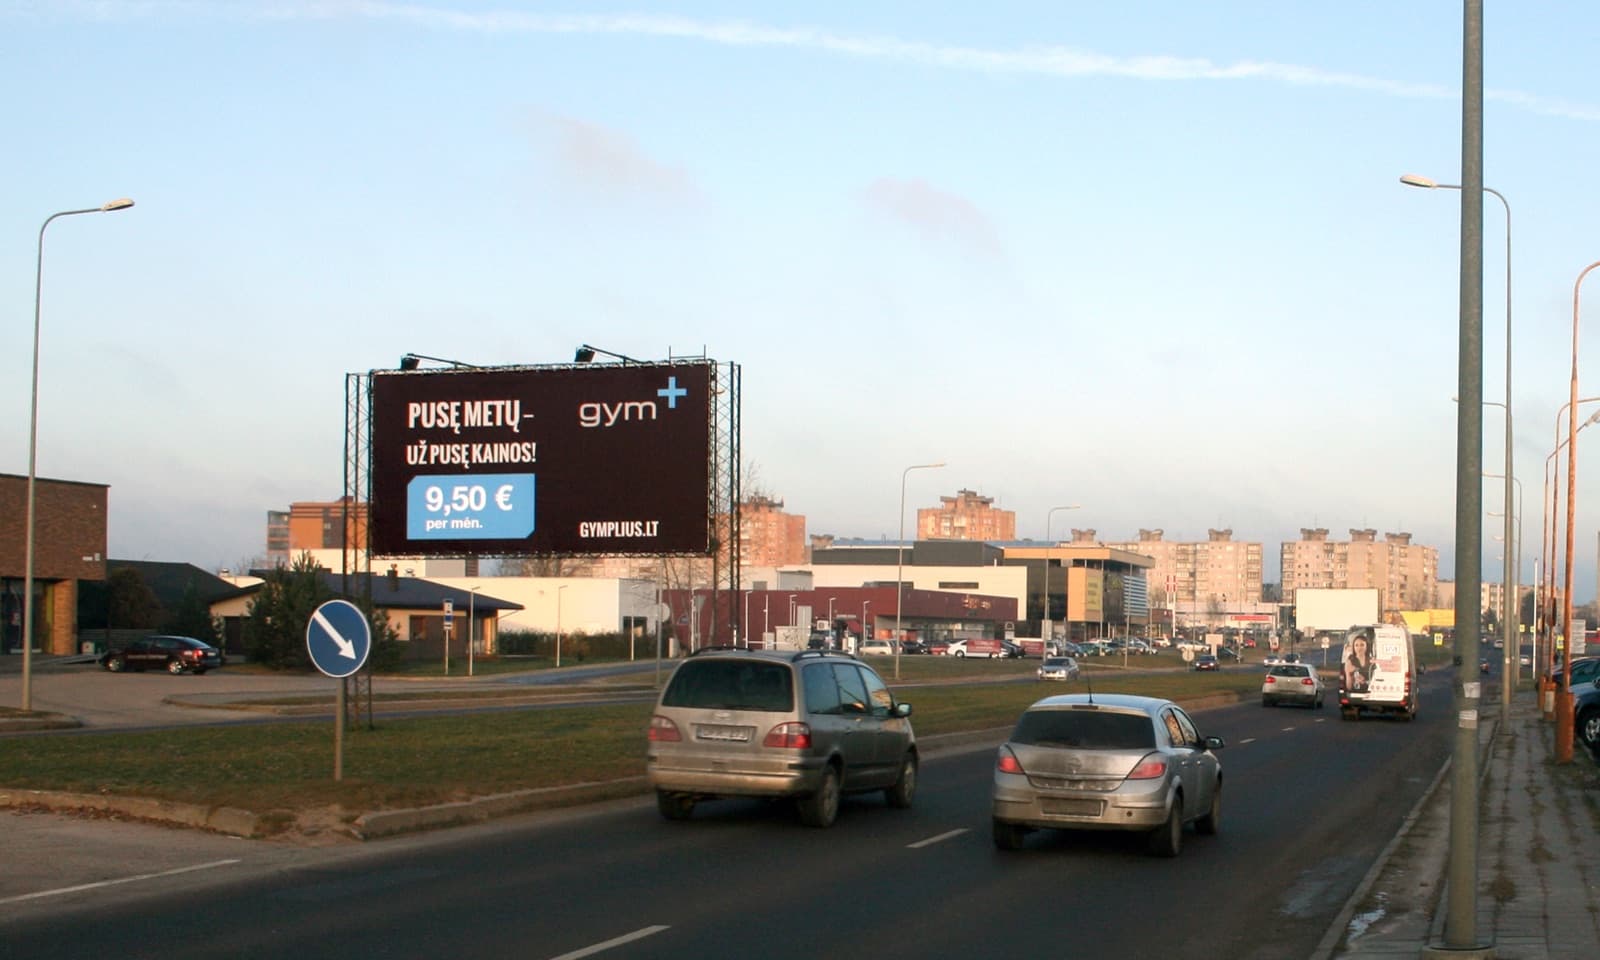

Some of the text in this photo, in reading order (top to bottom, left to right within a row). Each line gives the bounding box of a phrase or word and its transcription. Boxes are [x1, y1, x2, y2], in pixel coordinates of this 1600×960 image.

[408, 400, 461, 435] PUSĘ
[464, 399, 521, 433] METŲ
[406, 440, 537, 470] UŽ PUSĘ KAINOS!
[425, 484, 514, 517] 9,50 €
[425, 516, 484, 532] per mėn.
[579, 520, 660, 538] GYMPLIUS.LT
